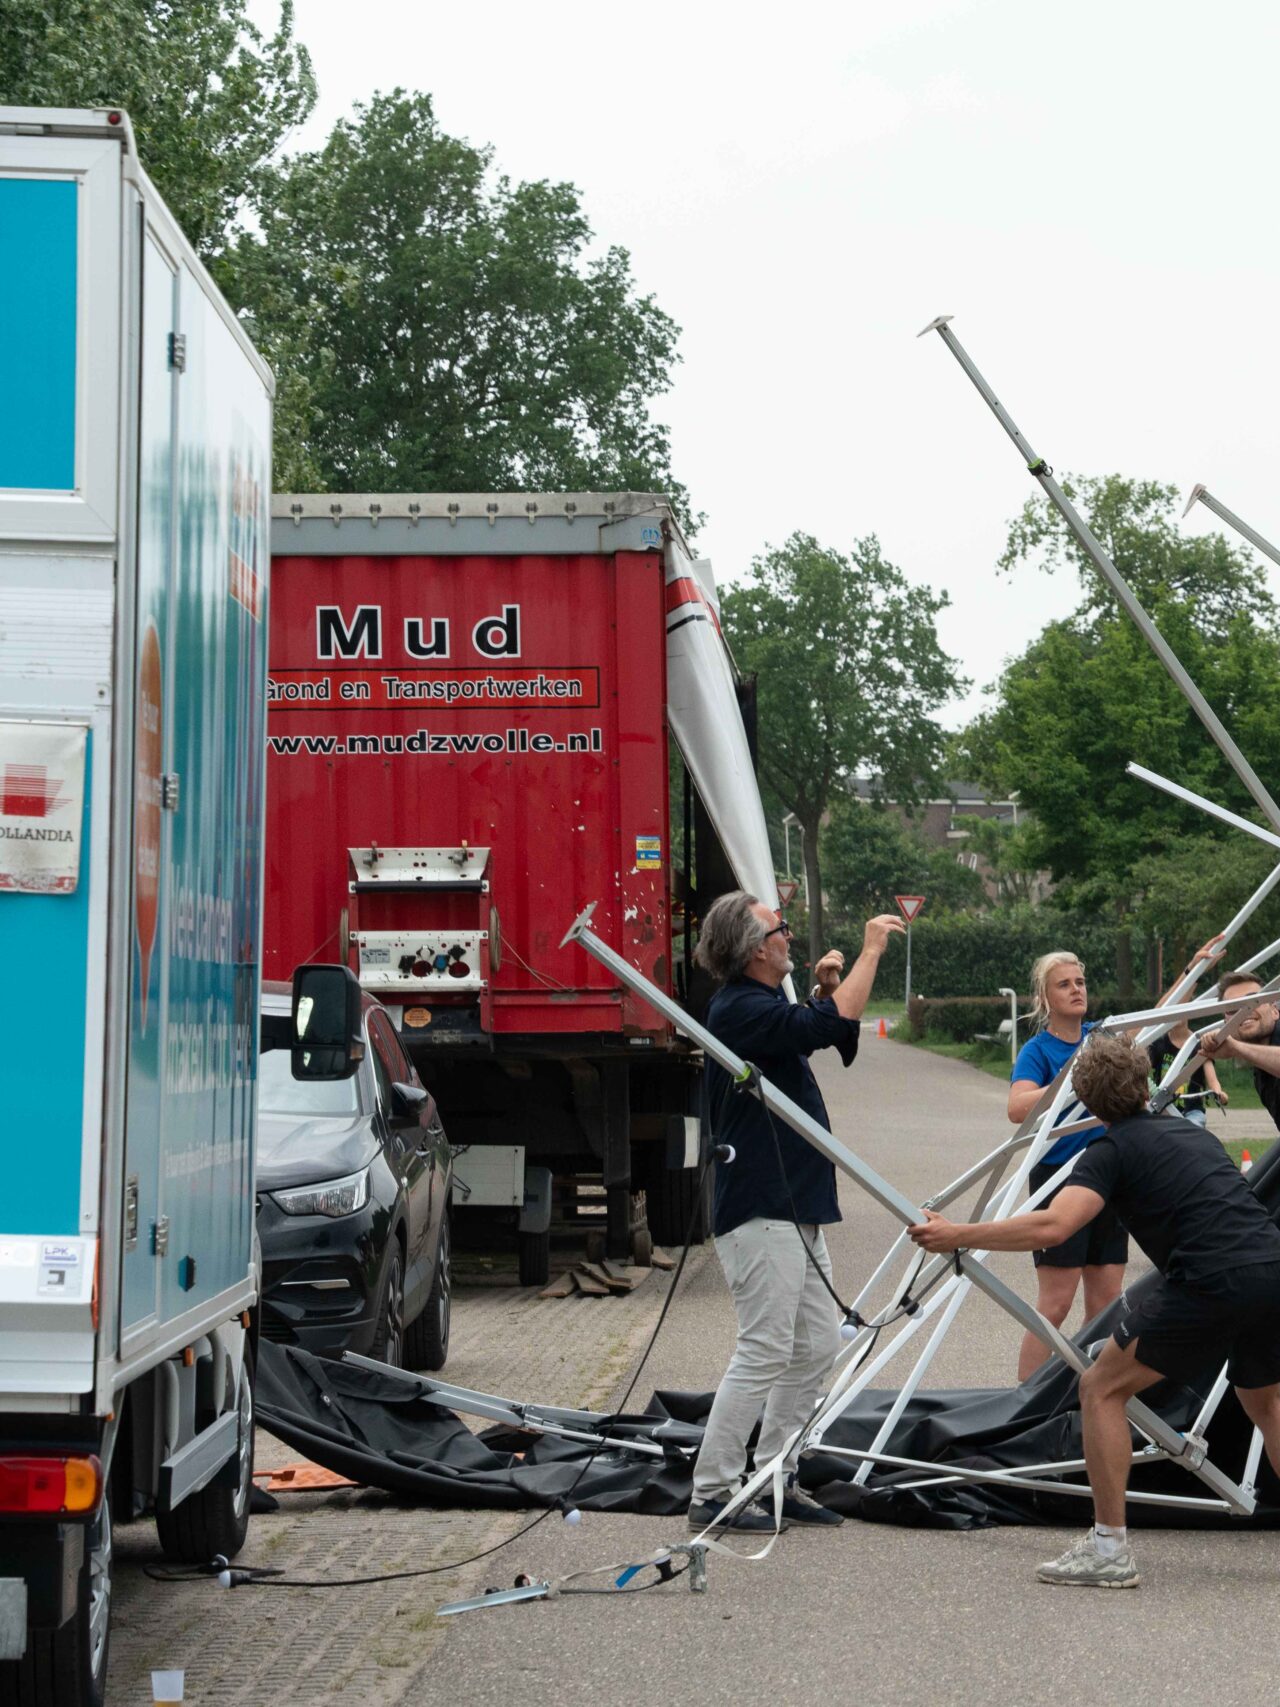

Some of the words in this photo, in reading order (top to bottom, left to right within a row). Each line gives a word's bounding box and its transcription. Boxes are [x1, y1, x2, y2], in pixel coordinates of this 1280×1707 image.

[316, 604, 521, 660] Mud
[340, 681, 370, 699] en
[381, 674, 582, 703] Transportwerken
[266, 728, 602, 755] ww.mudzwolle.nl
